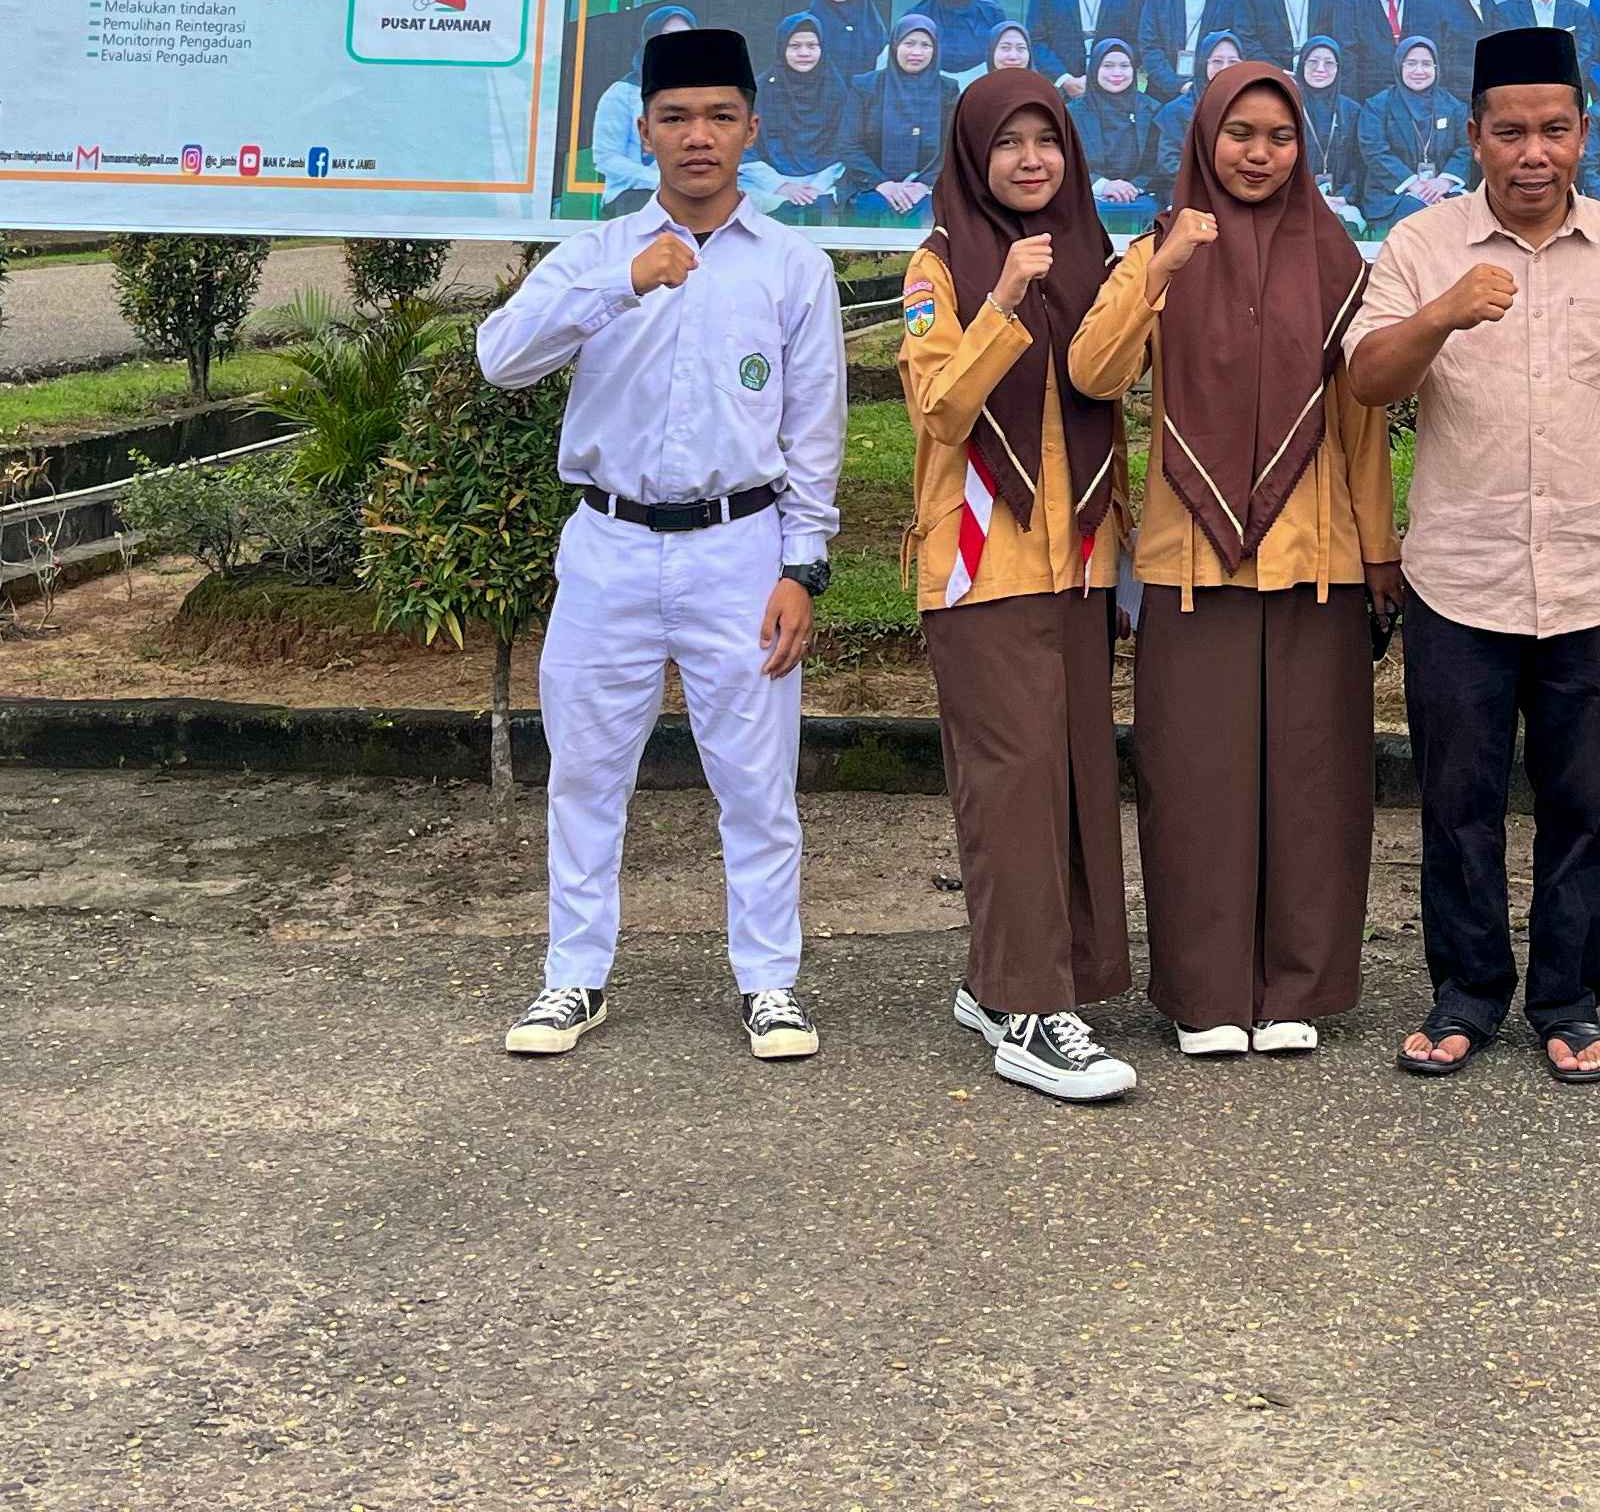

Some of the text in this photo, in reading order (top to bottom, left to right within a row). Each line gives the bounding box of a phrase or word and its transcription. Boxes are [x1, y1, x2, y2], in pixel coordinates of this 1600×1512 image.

[105, 0, 235, 15] Melakukan tindakan
[381, 18, 491, 32] PUSAT LAYANAN
[102, 33, 251, 52] Monitoring Pengaduan
[101, 49, 227, 66] Evaluasi Pengaduan
